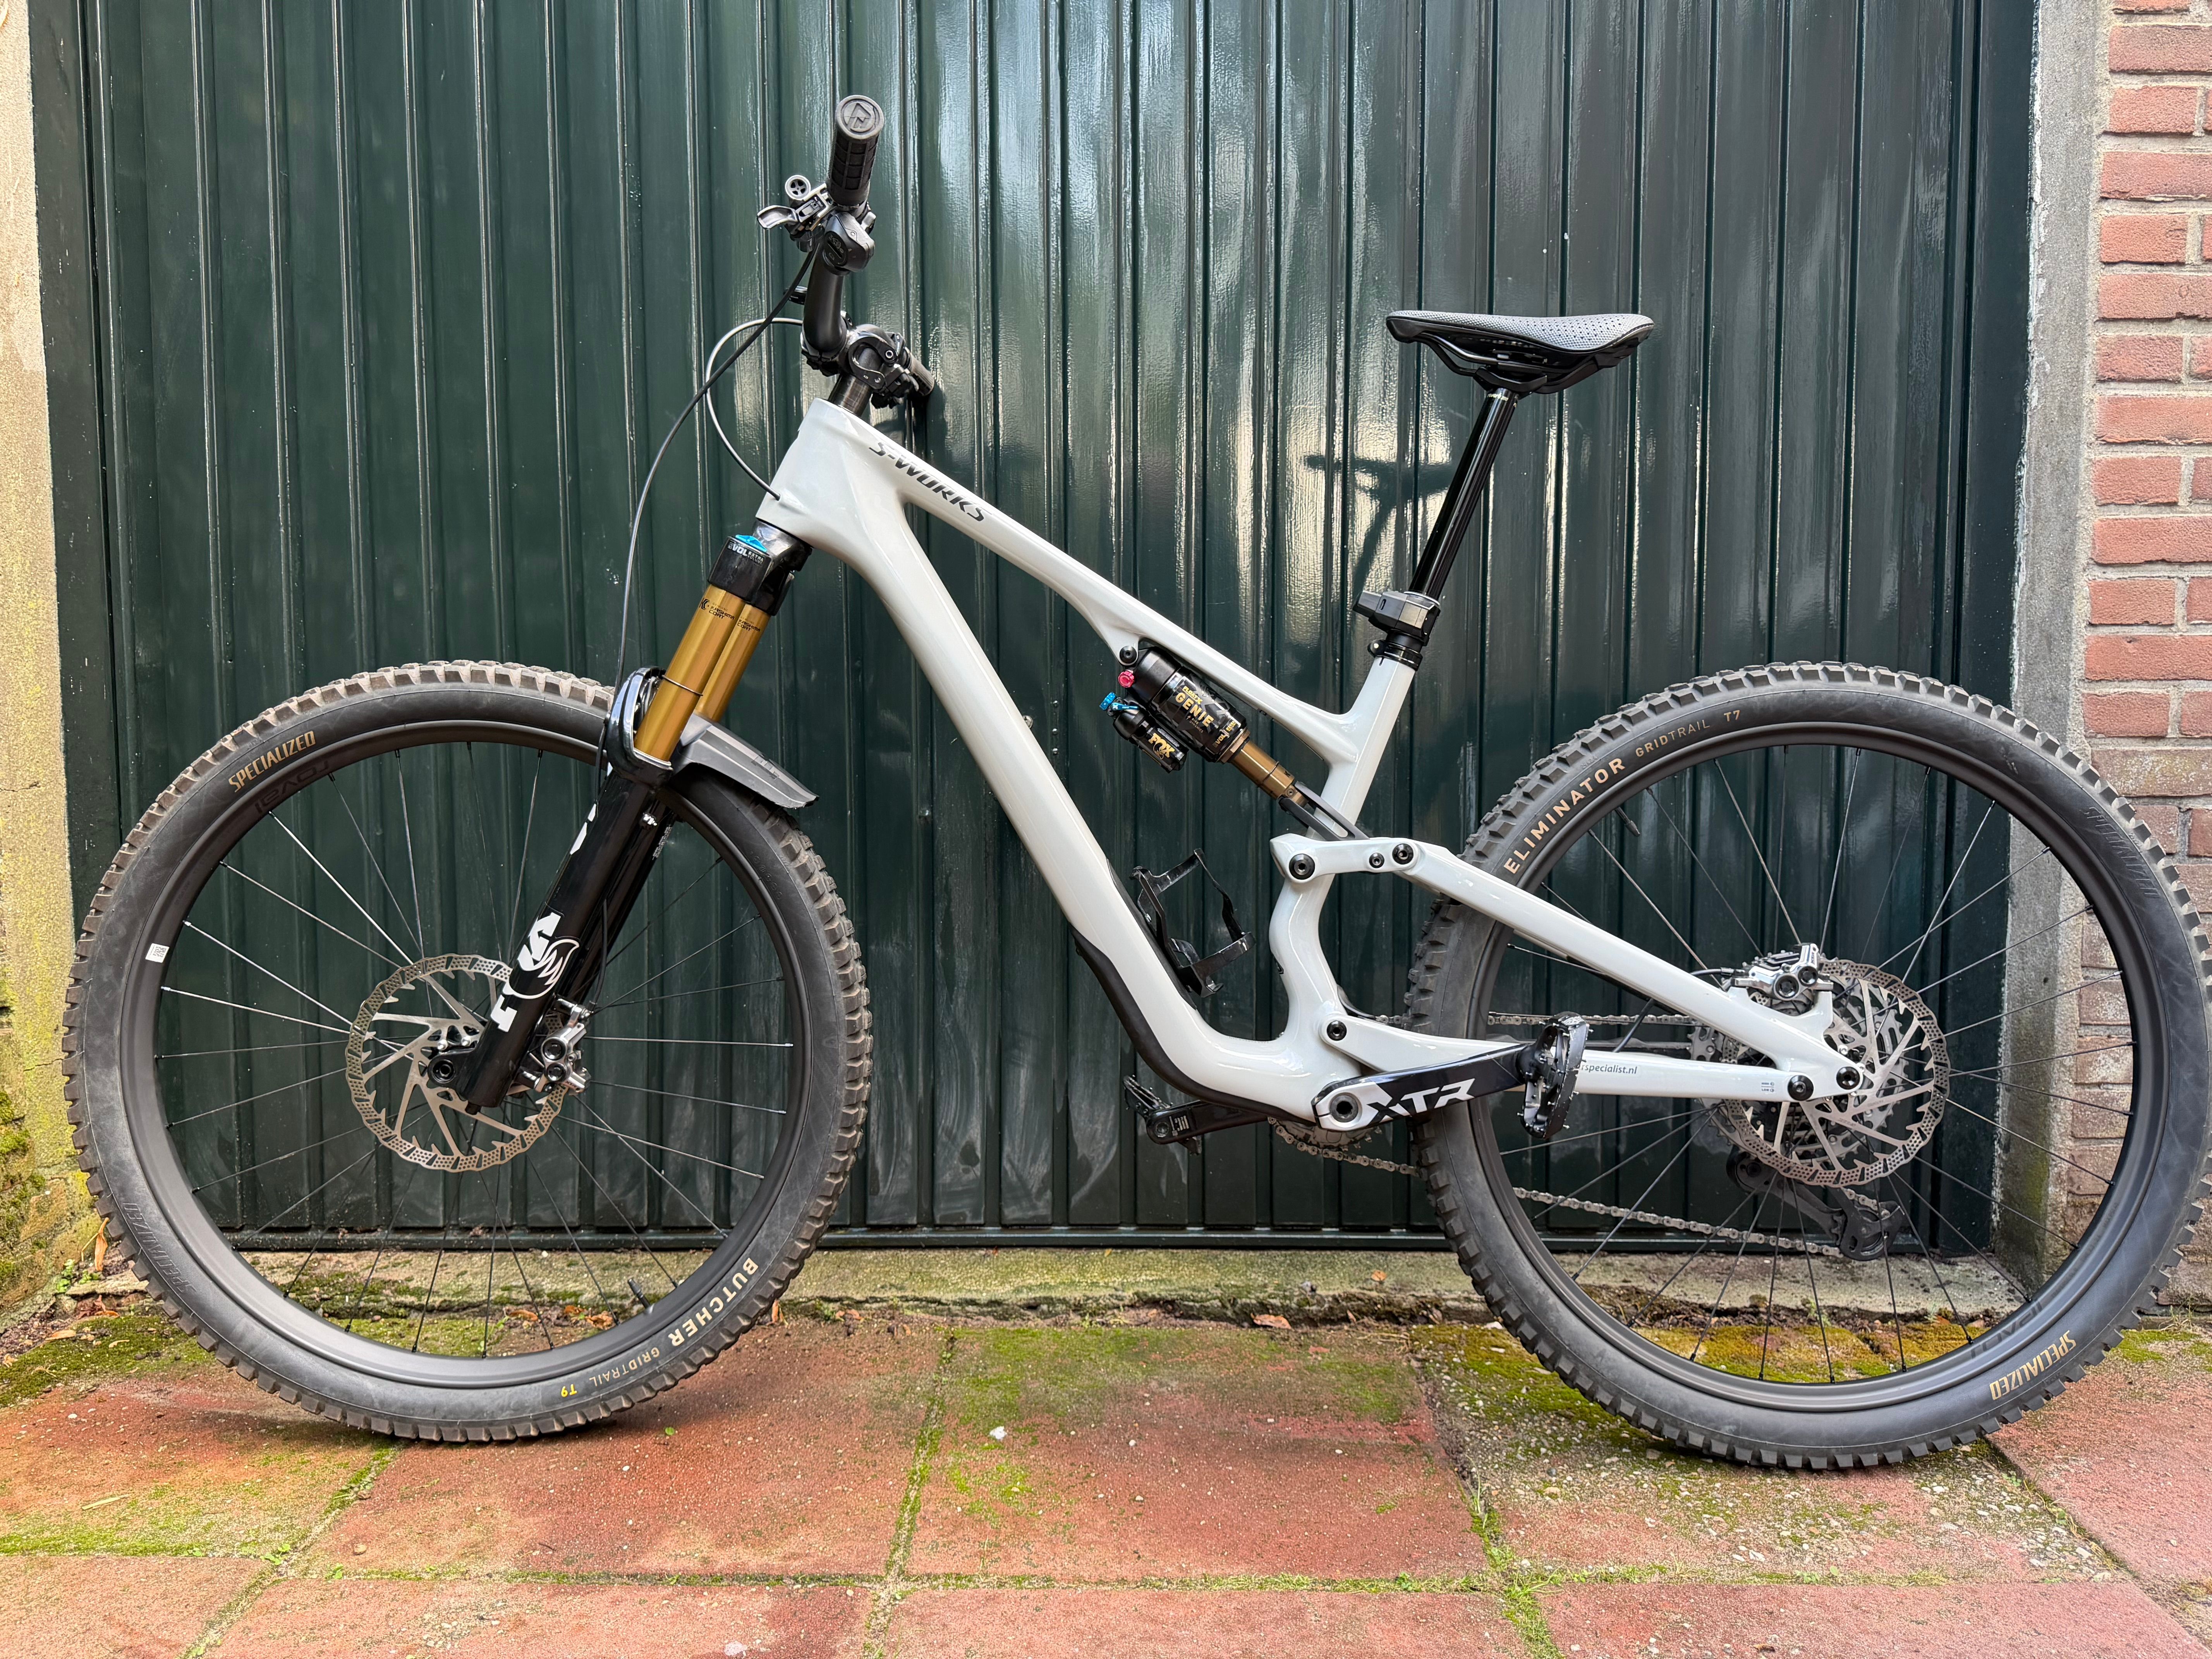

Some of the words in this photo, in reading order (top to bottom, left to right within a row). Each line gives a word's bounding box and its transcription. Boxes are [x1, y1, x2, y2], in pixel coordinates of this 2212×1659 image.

[869, 441, 985, 522] S-WORKS
[710, 606, 735, 620] KASHIMA
[1175, 692, 1214, 727] GENIE
[228, 731, 316, 793] SPECIALIZED
[1148, 733, 1175, 759] FOX
[1504, 758, 1626, 874] ELIMINATOR
[1635, 719, 1710, 757] GRIDTRAIL
[1724, 710, 1741, 722] T7
[1580, 1064, 1637, 1074] rspecialist.nl
[1366, 1078, 1475, 1124] XTR
[122, 1202, 197, 1292] SPECIALIZED
[668, 1257, 758, 1346] BUTCHER
[589, 1347, 660, 1387] GRIDTRAIL
[1989, 1330, 2076, 1400] SPECIALIZED
[561, 1384, 577, 1397] T9
